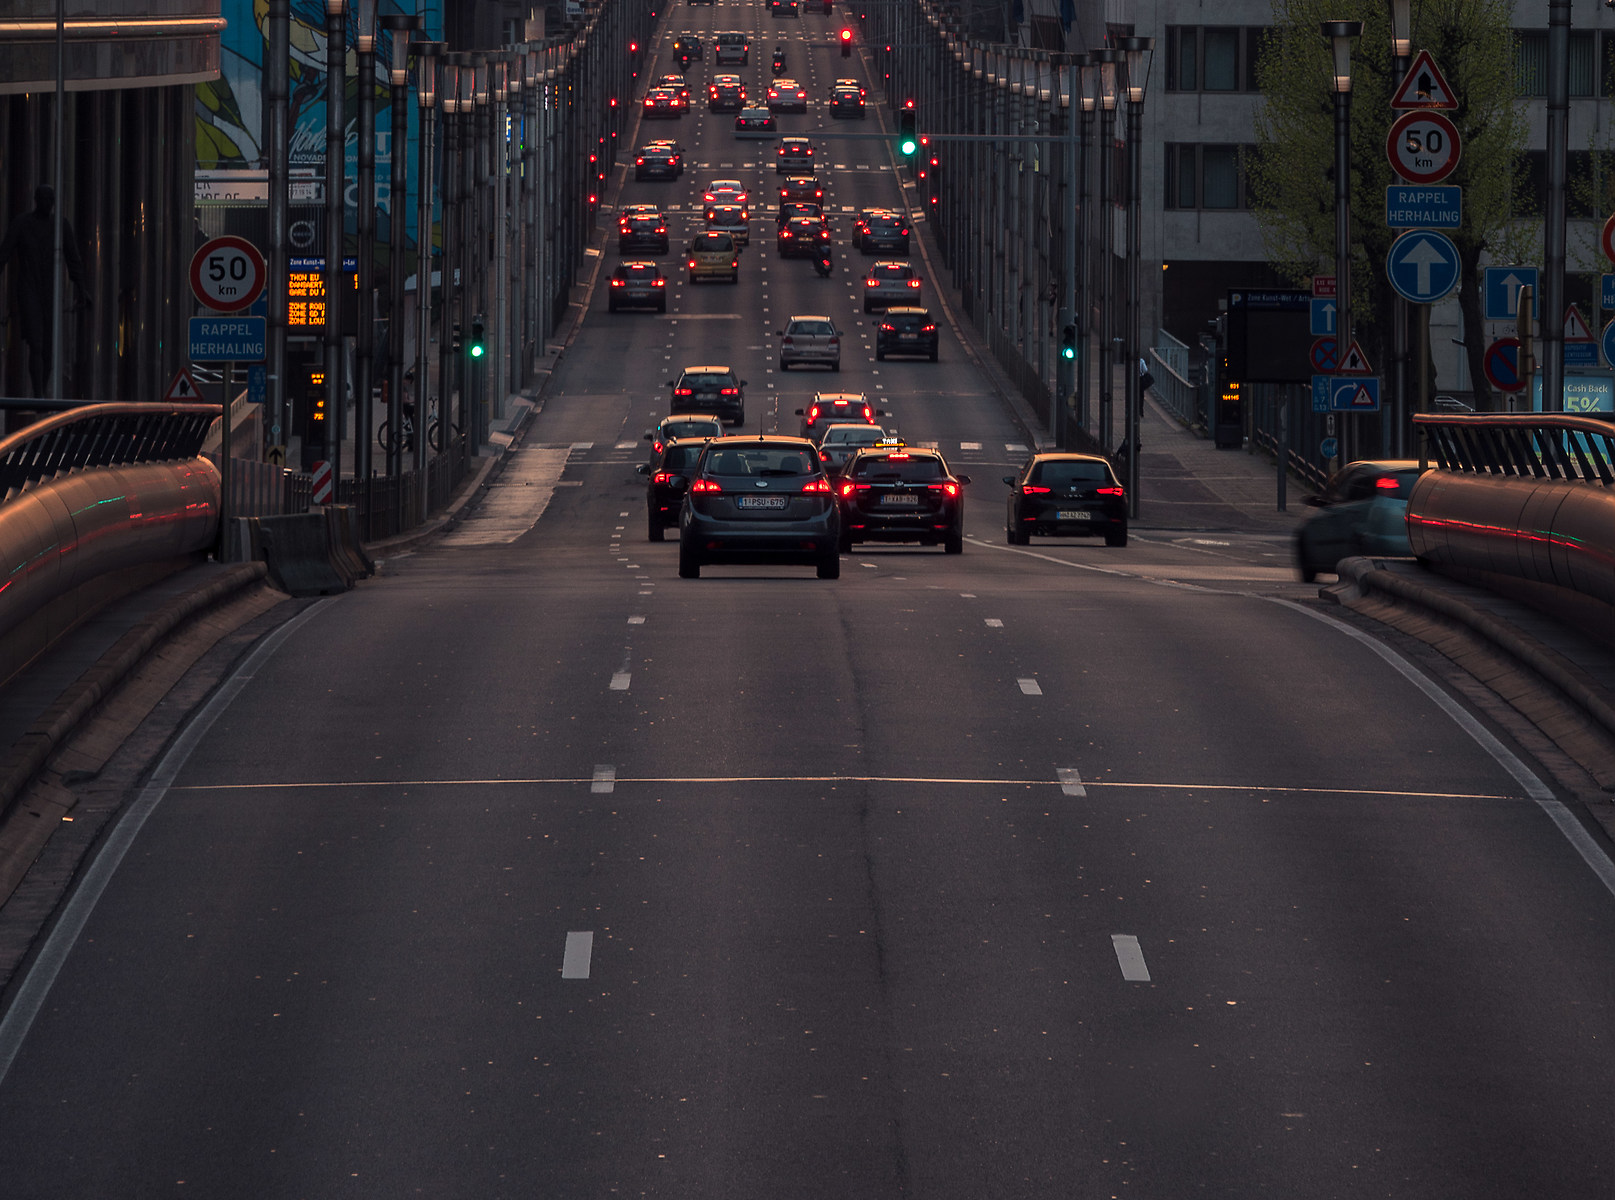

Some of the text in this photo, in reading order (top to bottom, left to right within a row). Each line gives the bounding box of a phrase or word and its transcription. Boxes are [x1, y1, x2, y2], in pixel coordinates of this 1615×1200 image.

[1406, 130, 1442, 154] 50
[1415, 157, 1433, 167] km
[1399, 192, 1449, 204] RAPPEL
[1389, 210, 1459, 222] HERHALING
[209, 257, 247, 281] 50
[309, 273, 320, 281] EU
[219, 285, 237, 295] km
[1232, 293, 1242, 306] P
[201, 324, 252, 336] RAPPEL
[191, 343, 263, 355] HERHALING
[1567, 384, 1608, 393] Cash Back
